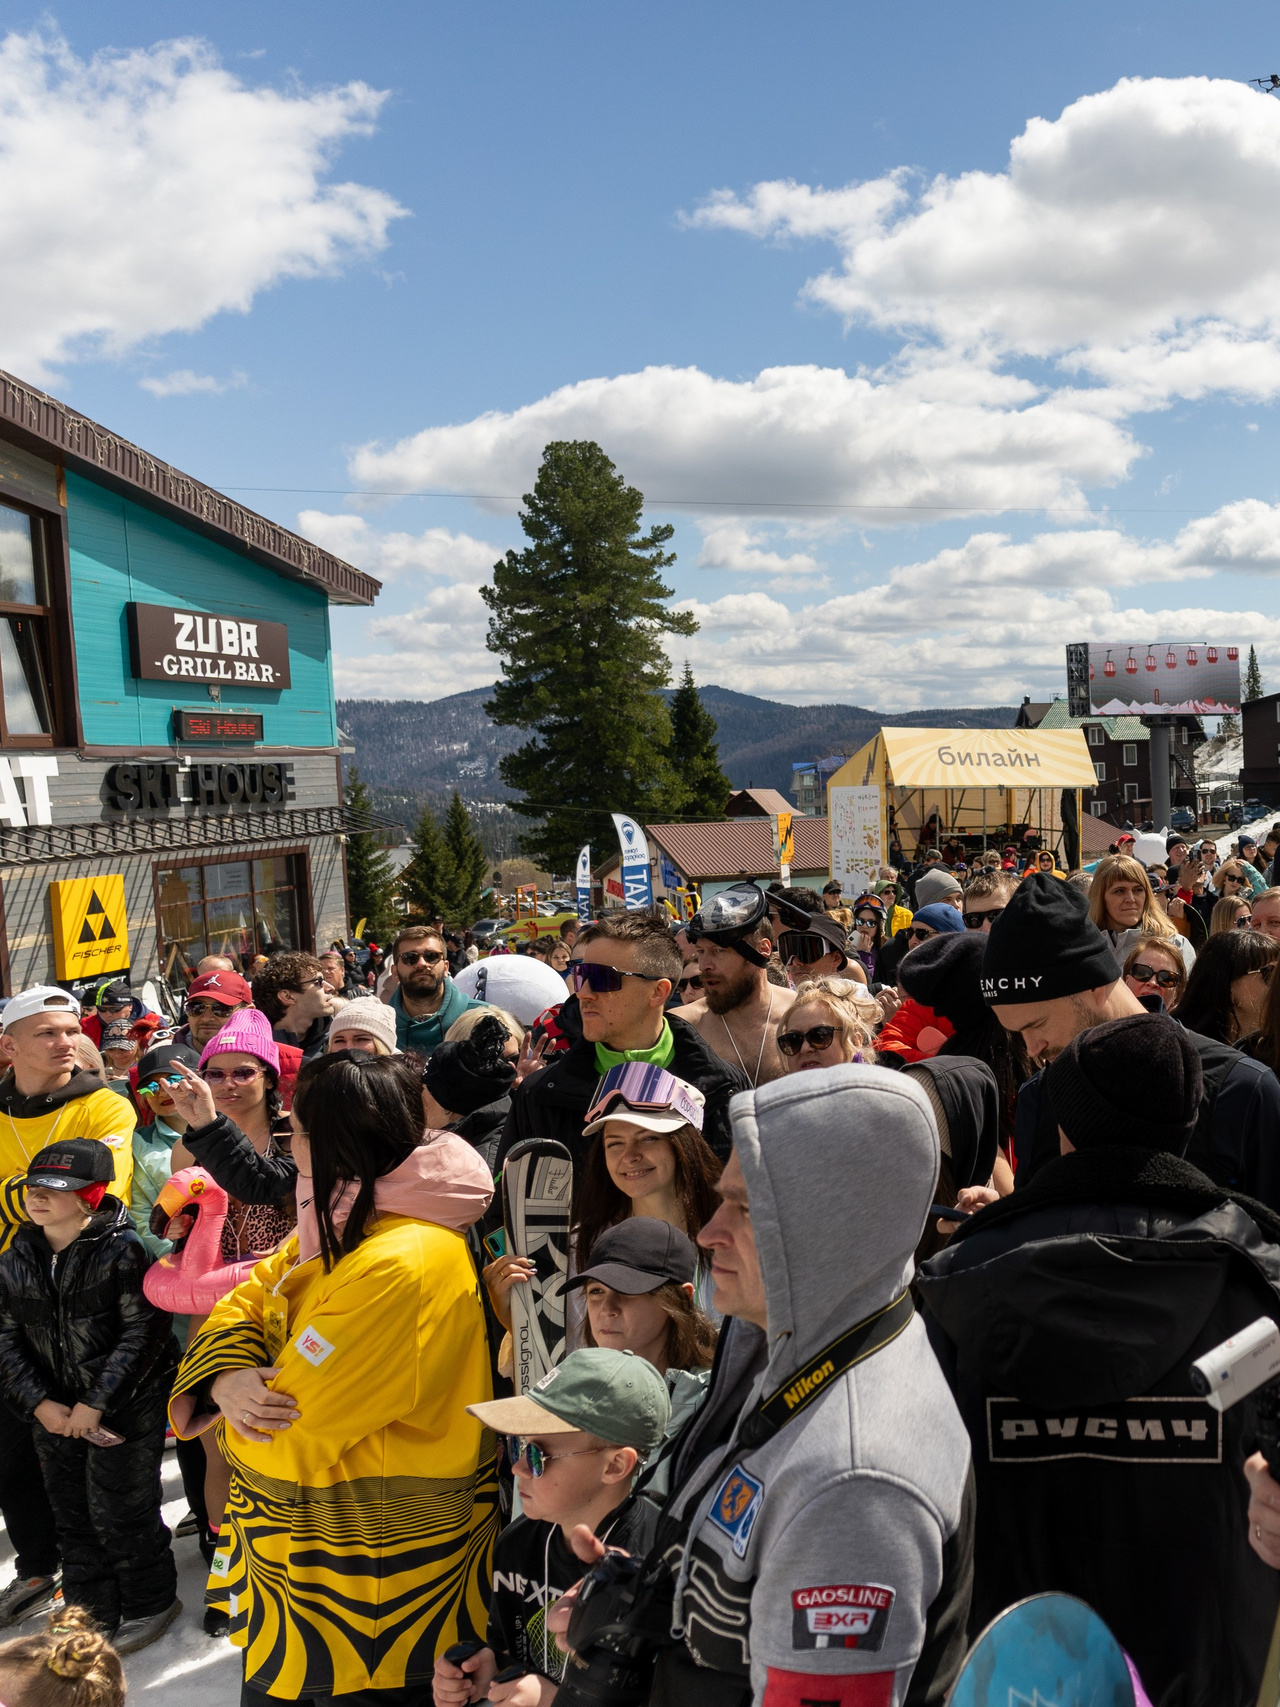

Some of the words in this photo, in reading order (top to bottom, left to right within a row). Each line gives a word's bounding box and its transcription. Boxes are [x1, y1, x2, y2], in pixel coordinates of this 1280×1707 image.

[173, 612, 260, 658] ZUBR
[189, 719, 211, 735] Ski
[216, 720, 256, 736] House
[937, 745, 1042, 768] билайн
[105, 763, 181, 811] SKI
[190, 762, 297, 803] HOUSE
[71, 944, 122, 961] FISCHER
[35, 1152, 75, 1168] FIRE
[783, 1359, 835, 1410] Nikon
[796, 1587, 888, 1607] GAOSLINE
